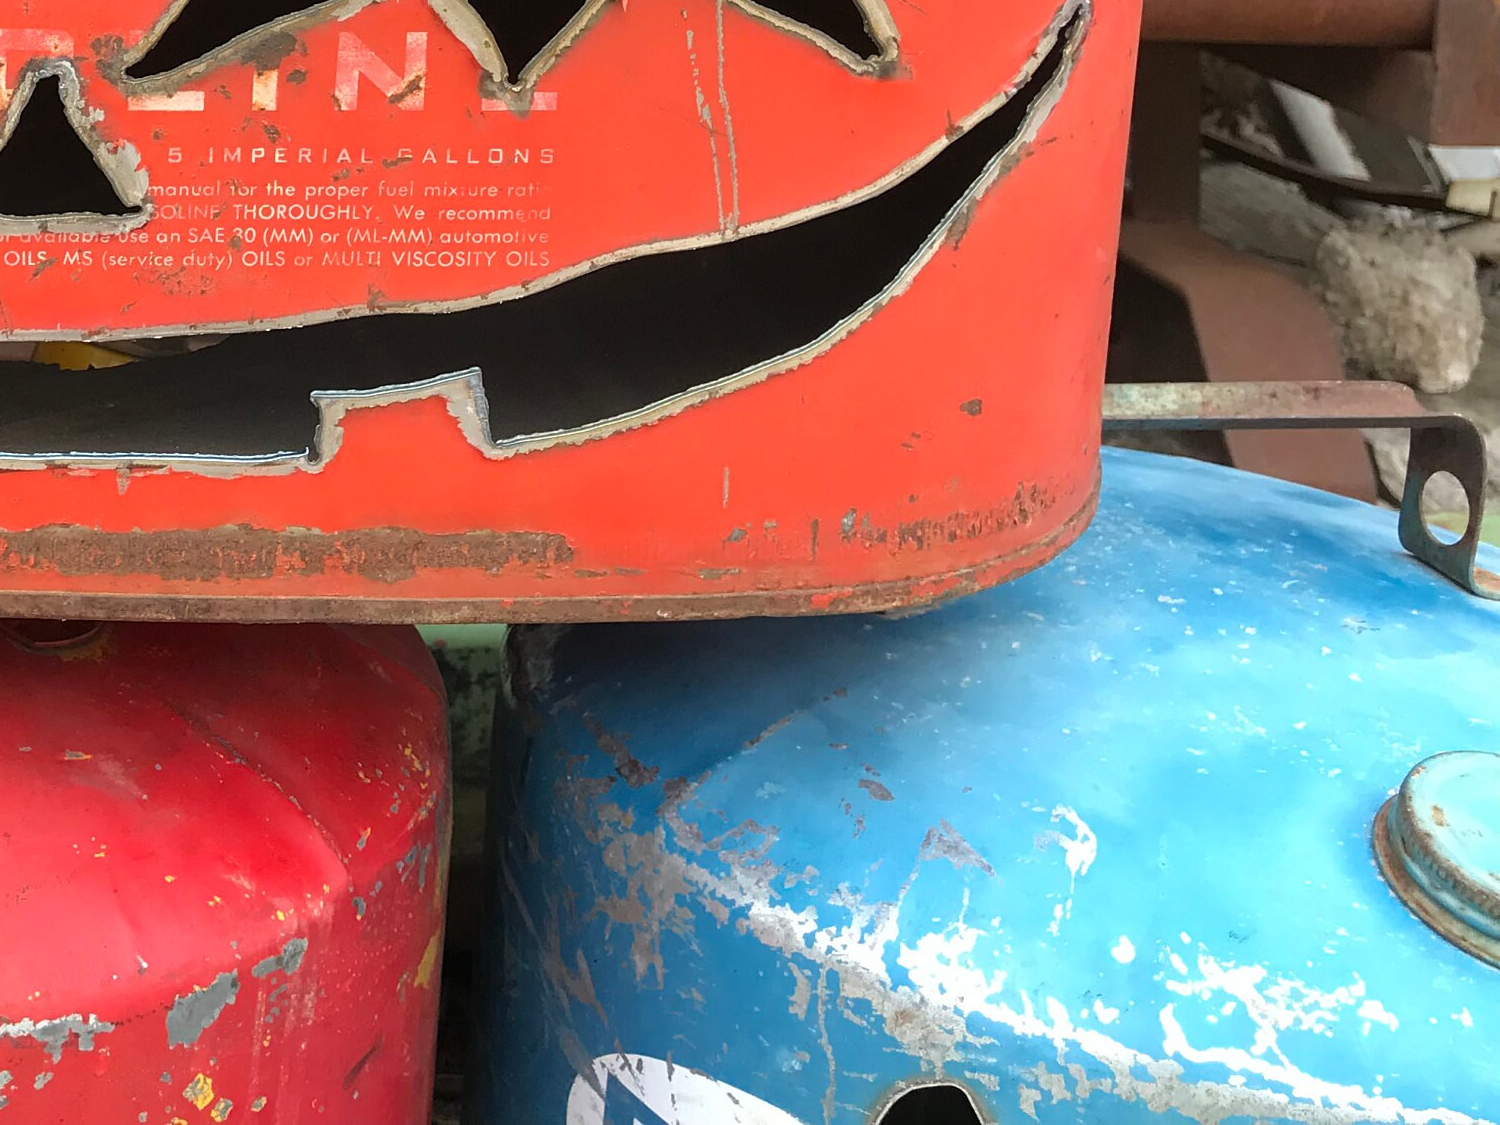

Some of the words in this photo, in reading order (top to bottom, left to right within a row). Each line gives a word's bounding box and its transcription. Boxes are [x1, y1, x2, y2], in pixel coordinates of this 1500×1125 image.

[207, 147, 374, 164] IMPERIAL
[396, 147, 556, 165] GALLONS
[148, 179, 221, 198] manual
[265, 179, 296, 198] the
[304, 184, 369, 202] proper
[378, 180, 414, 197] fuel
[393, 204, 427, 222] We
[437, 206, 552, 223] recommend
[117, 231, 150, 244] use
[156, 229, 182, 245] an
[187, 227, 226, 244] SAE
[262, 226, 315, 248] (MM)
[319, 231, 340, 245] or
[346, 226, 433, 248] (ML-MM)
[439, 229, 550, 245] automotive
[62, 251, 94, 267] MS
[101, 251, 174, 269] (service
[181, 249, 234, 271] duty)
[240, 250, 287, 268] OILS
[293, 254, 313, 268] or
[321, 250, 382, 268] MULTI
[392, 250, 498, 268] VISCOSITY
[505, 250, 551, 268] OILS
